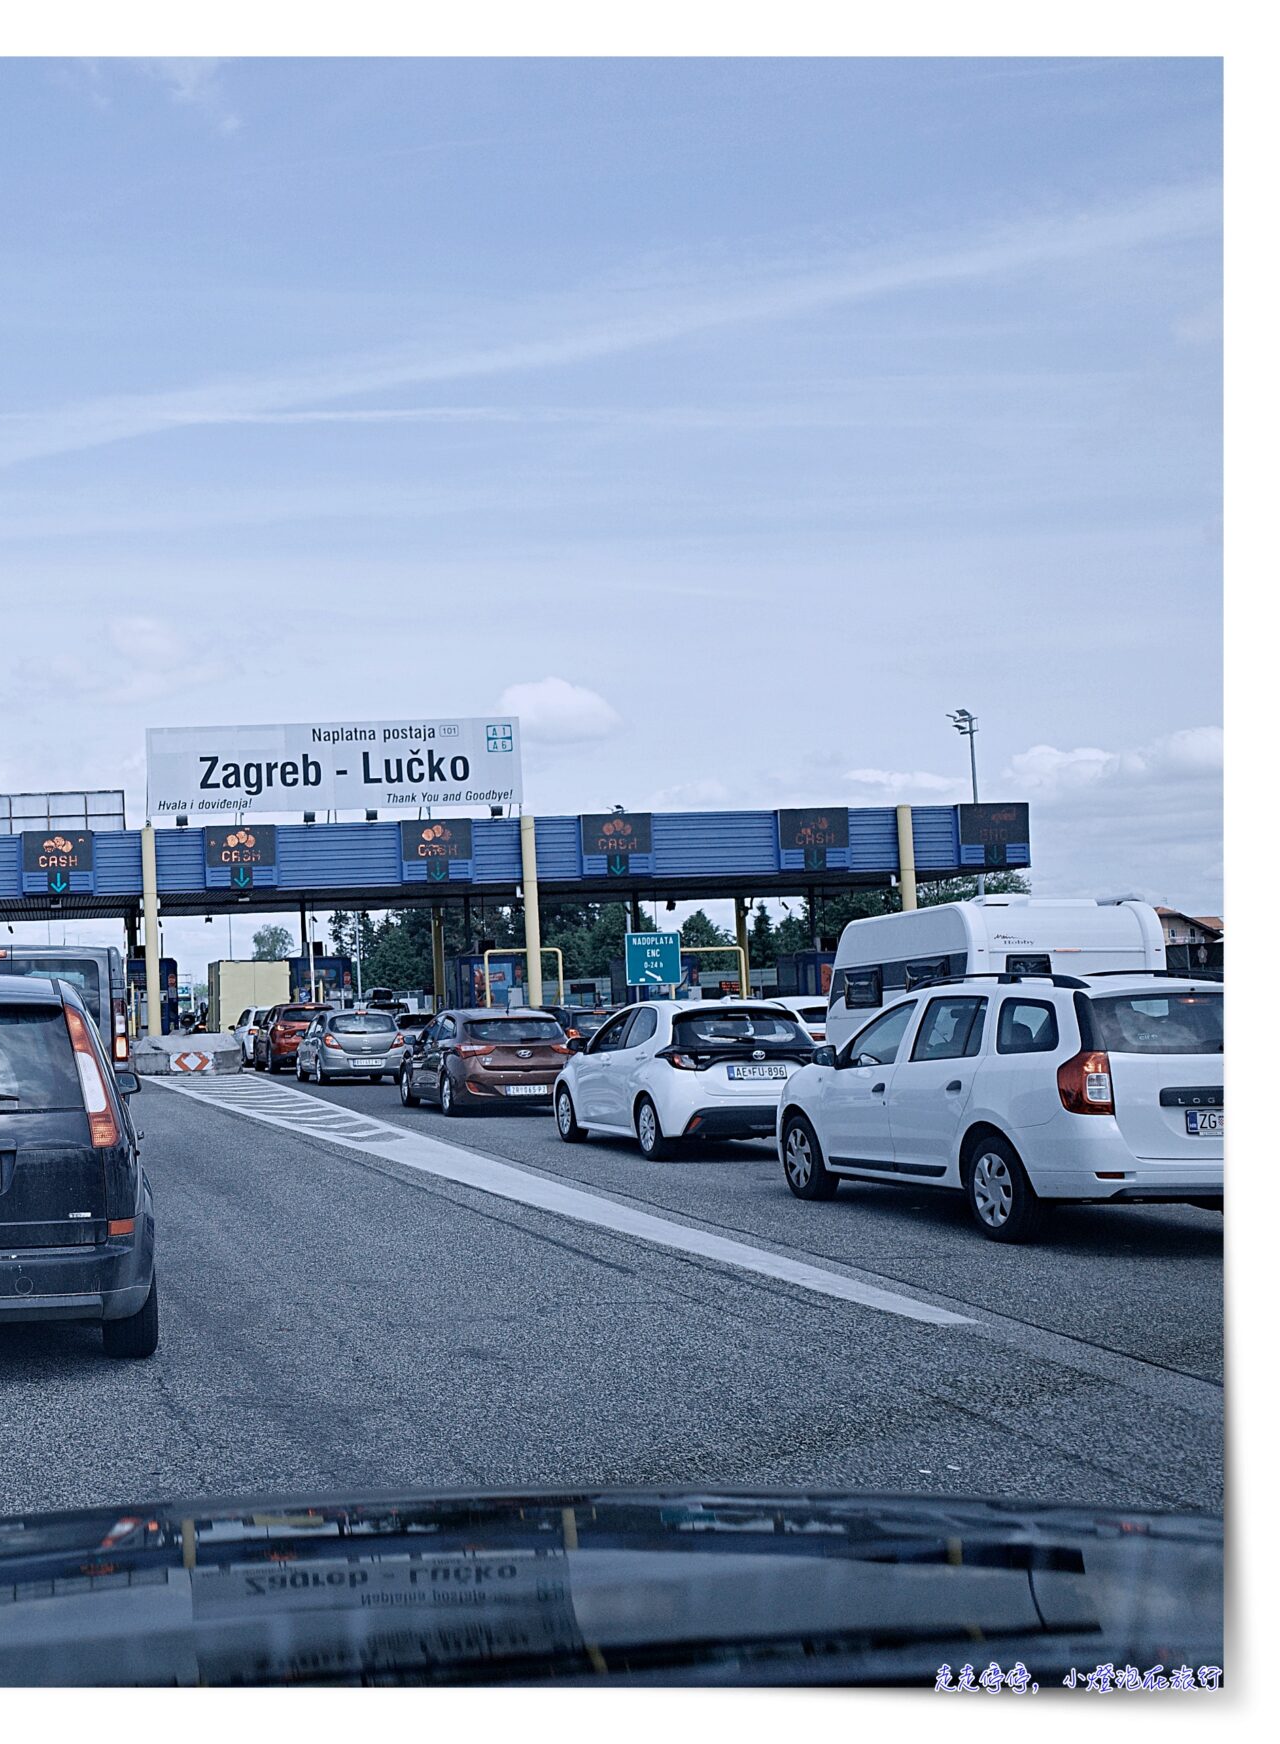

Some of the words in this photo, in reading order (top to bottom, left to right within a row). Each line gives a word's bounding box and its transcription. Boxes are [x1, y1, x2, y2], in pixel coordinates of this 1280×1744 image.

[311, 726, 377, 745] Naplatna
[382, 724, 436, 743] postaja
[441, 727, 457, 736] 101
[198, 753, 322, 796] Zagreb
[335, 768, 348, 776] -
[362, 748, 471, 785] Lučko
[386, 792, 417, 804] Thank
[421, 791, 439, 802] You
[442, 790, 462, 801] and
[465, 787, 514, 803] Goodbye!
[157, 799, 187, 811] Hvala
[190, 799, 194, 810] i
[198, 797, 253, 811] doviđenja!
[38, 855, 78, 868] CASH
[632, 936, 674, 945] NADOPLATA
[646, 948, 661, 958] ENC
[643, 961, 658, 969] 0-24
[1198, 1113, 1217, 1129] ZG
